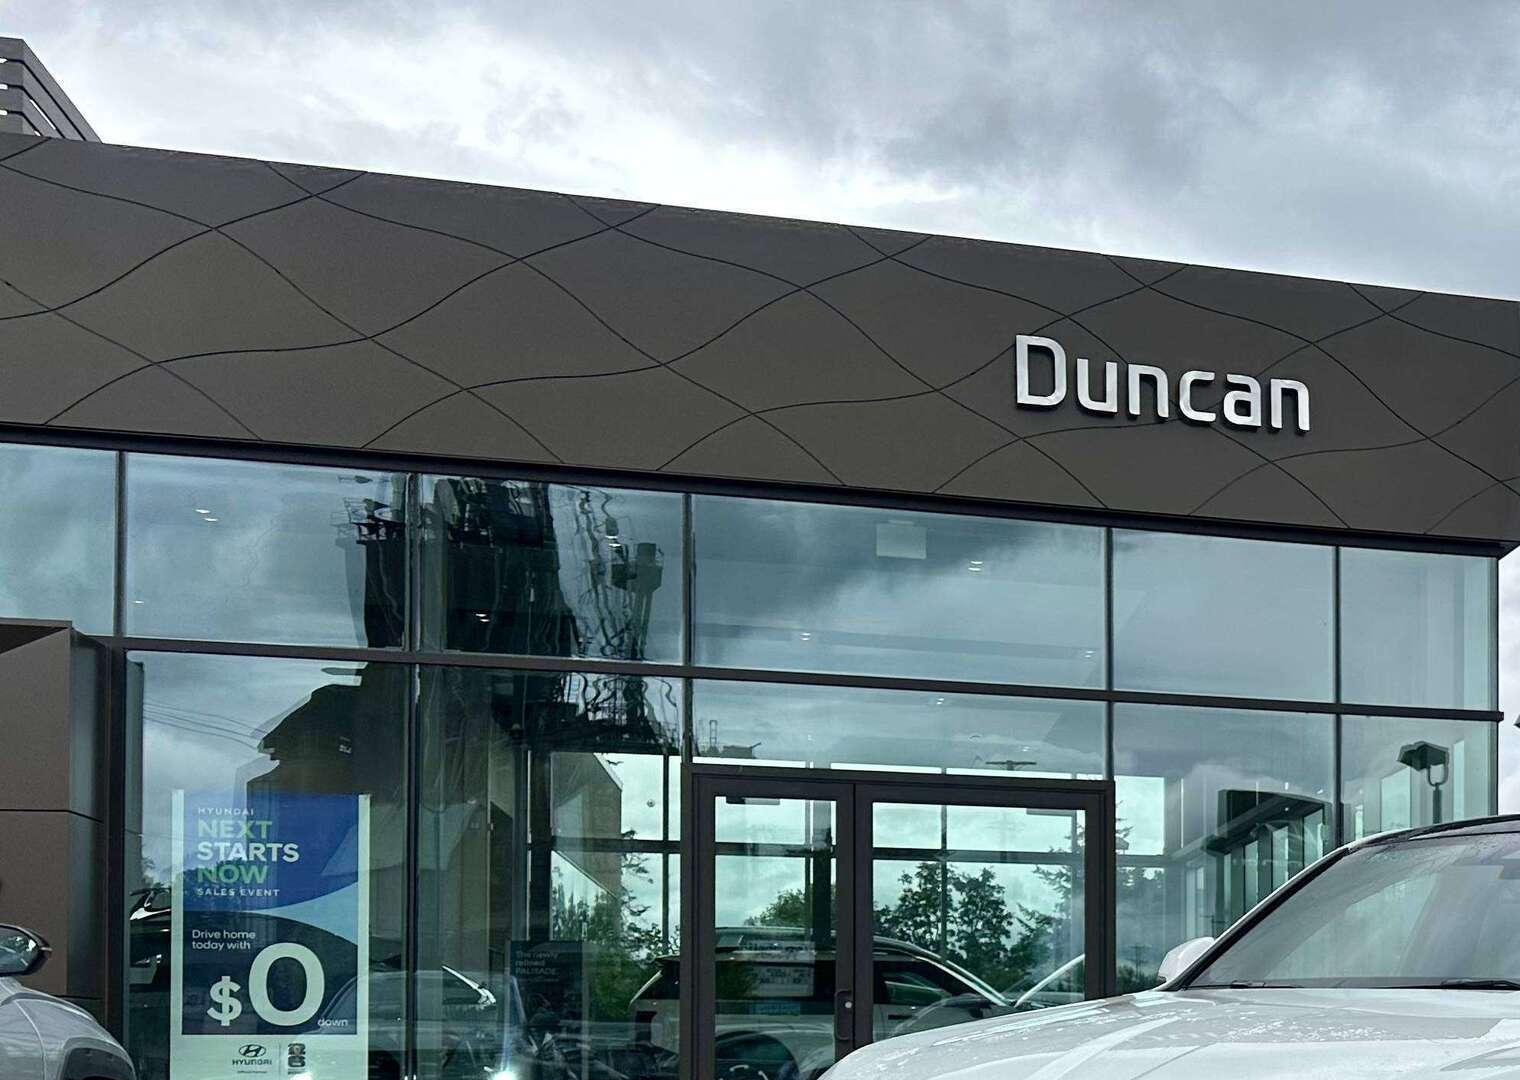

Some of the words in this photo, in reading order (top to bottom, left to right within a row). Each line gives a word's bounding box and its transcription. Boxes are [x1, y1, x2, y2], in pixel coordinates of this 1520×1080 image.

[1015, 334, 1311, 432] Duncan
[197, 807, 254, 816] HYUNDAI
[198, 819, 273, 839] NEXT
[197, 841, 300, 863] STARTS
[197, 864, 268, 884] NOW
[197, 888, 235, 897] SALES
[240, 889, 280, 897] EVENT
[192, 929, 221, 940] Drive
[223, 929, 256, 940] home
[192, 940, 224, 951] today
[226, 941, 251, 950] with
[317, 1018, 349, 1028] down
